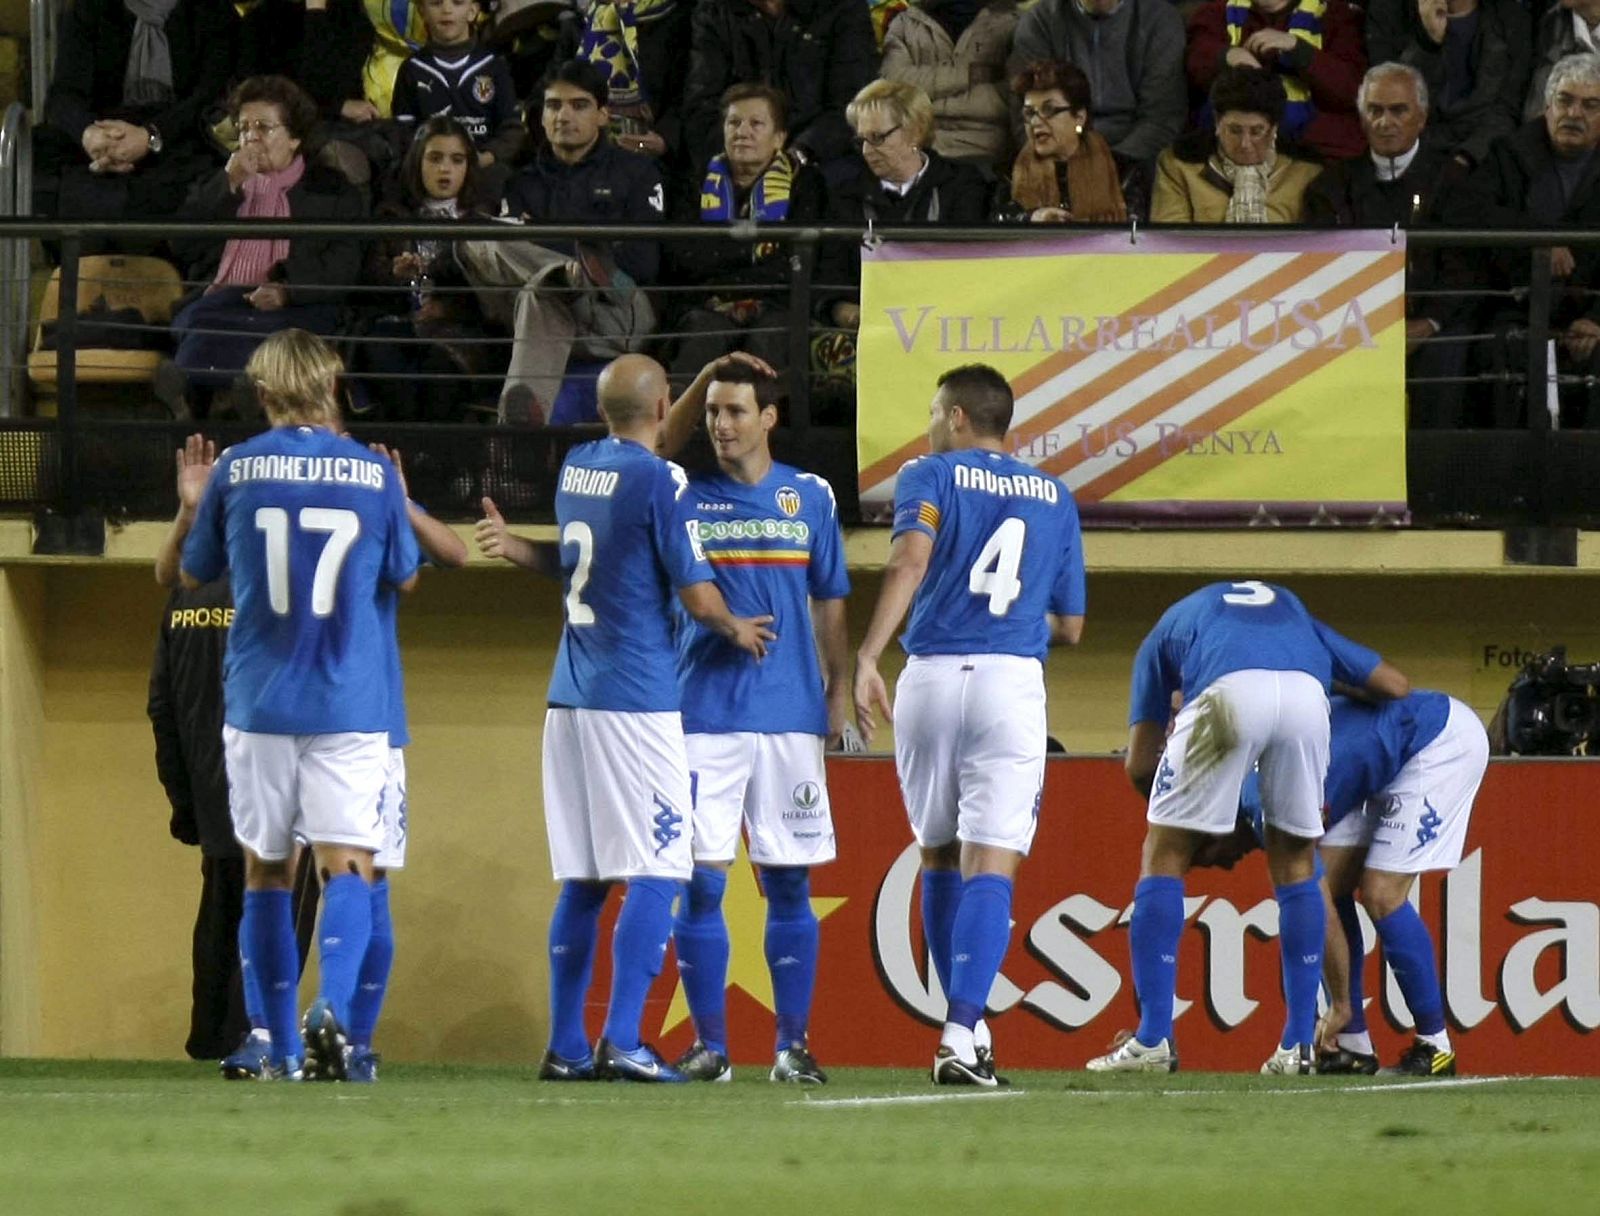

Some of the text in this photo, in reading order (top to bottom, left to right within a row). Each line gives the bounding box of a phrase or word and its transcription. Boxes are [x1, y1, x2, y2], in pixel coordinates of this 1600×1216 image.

[1077, 422, 1138, 458] US
[1155, 422, 1284, 458] PENYA
[229, 455, 385, 490] STANKEVICIUS
[561, 465, 619, 496] BRUNO
[954, 464, 1058, 504] NAVARRO
[714, 519, 808, 539] UNIBET
[254, 506, 361, 619] 17
[563, 521, 595, 624] 2
[968, 517, 1026, 616] 4
